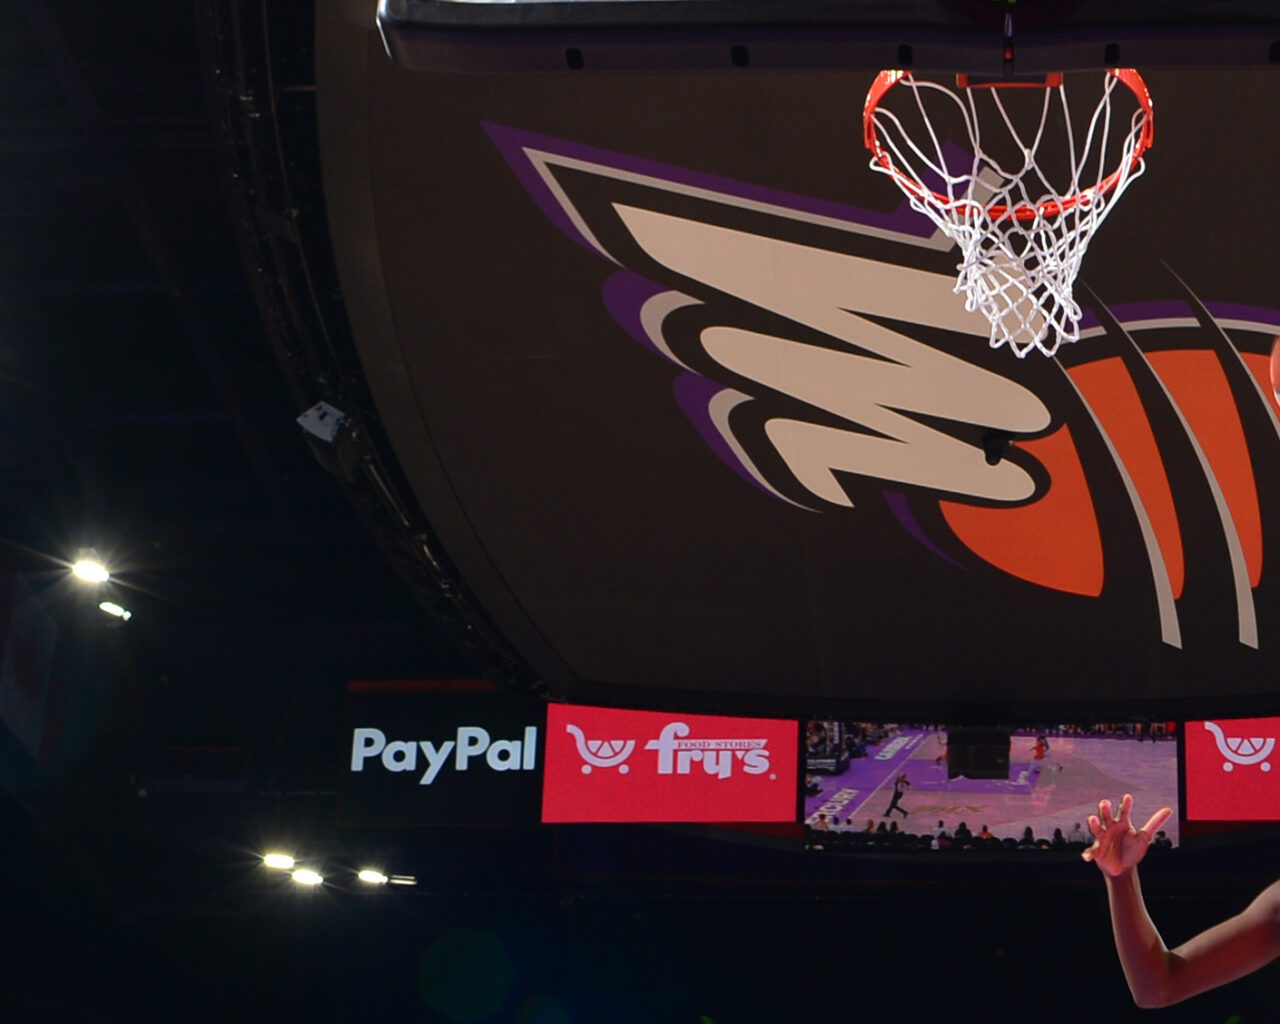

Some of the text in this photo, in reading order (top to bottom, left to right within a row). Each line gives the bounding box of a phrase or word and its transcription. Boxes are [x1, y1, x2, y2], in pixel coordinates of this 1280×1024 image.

[351, 726, 537, 785] PayPal
[644, 722, 770, 779] fry's
[678, 740, 763, 749] FOOD STORES
